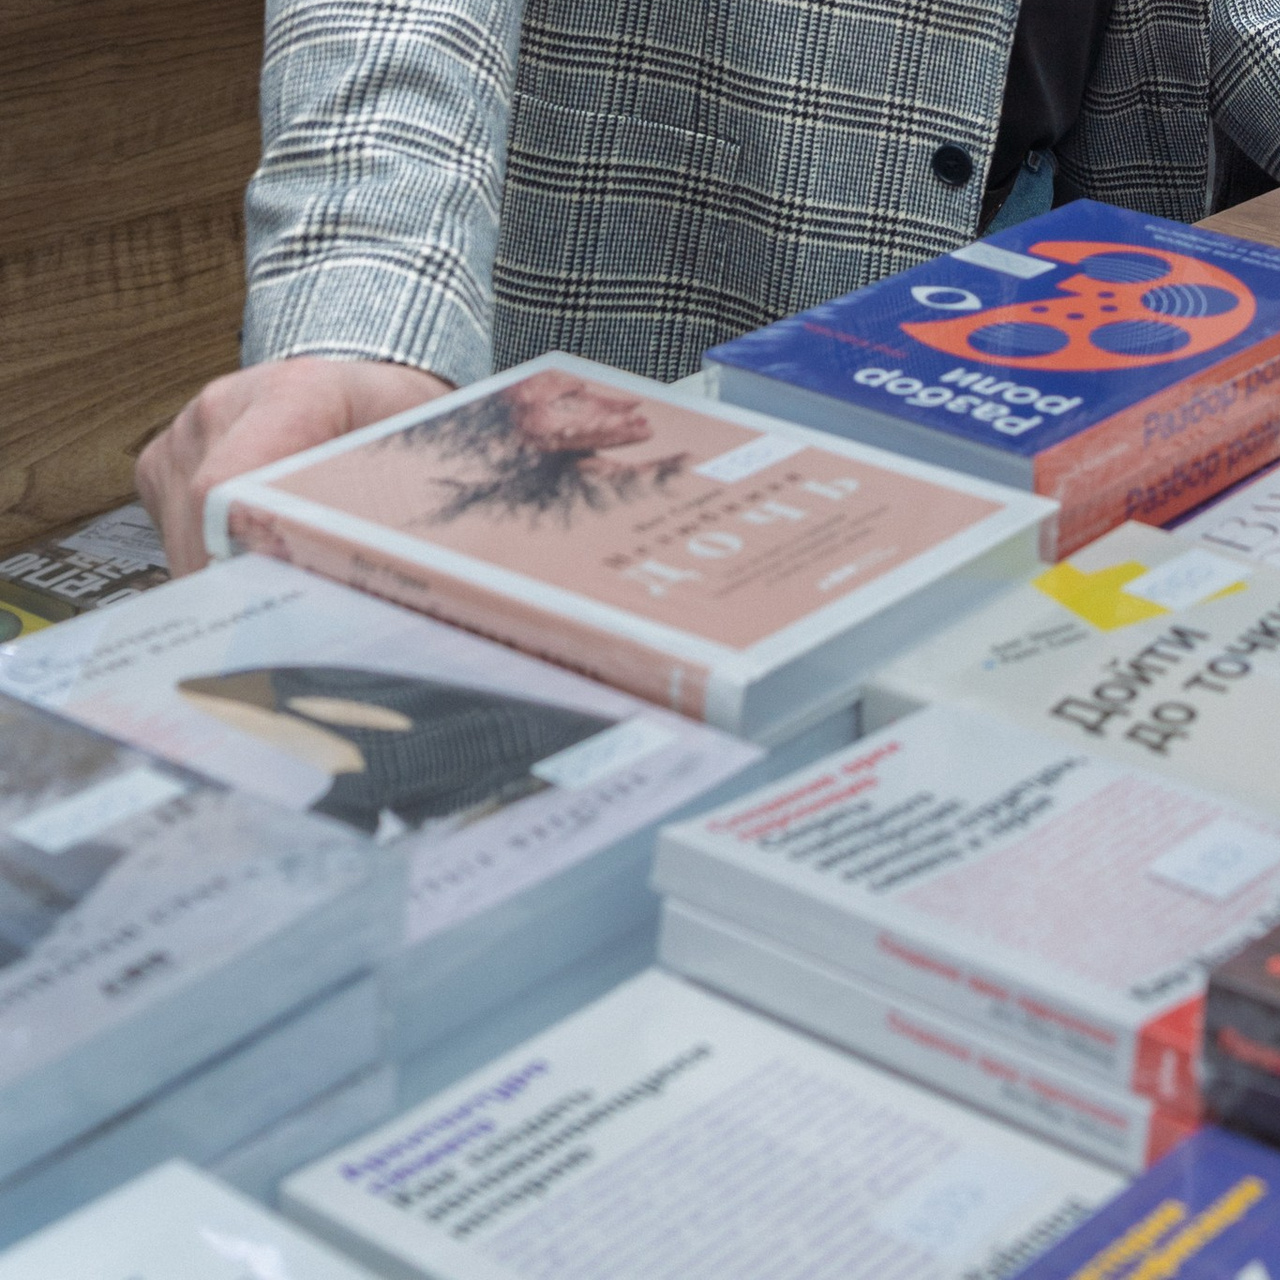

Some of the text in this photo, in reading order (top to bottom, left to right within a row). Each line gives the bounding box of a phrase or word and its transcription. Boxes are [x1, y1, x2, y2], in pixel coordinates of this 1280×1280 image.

[853, 366, 1043, 437] Разбор
[939, 366, 1084, 416] роли
[1142, 374, 1239, 448] Разбор
[1124, 440, 1222, 520] Разбор
[623, 474, 862, 597] ДОЧЬ
[1050, 621, 1210, 736] Дойти
[1127, 700, 1198, 758] до
